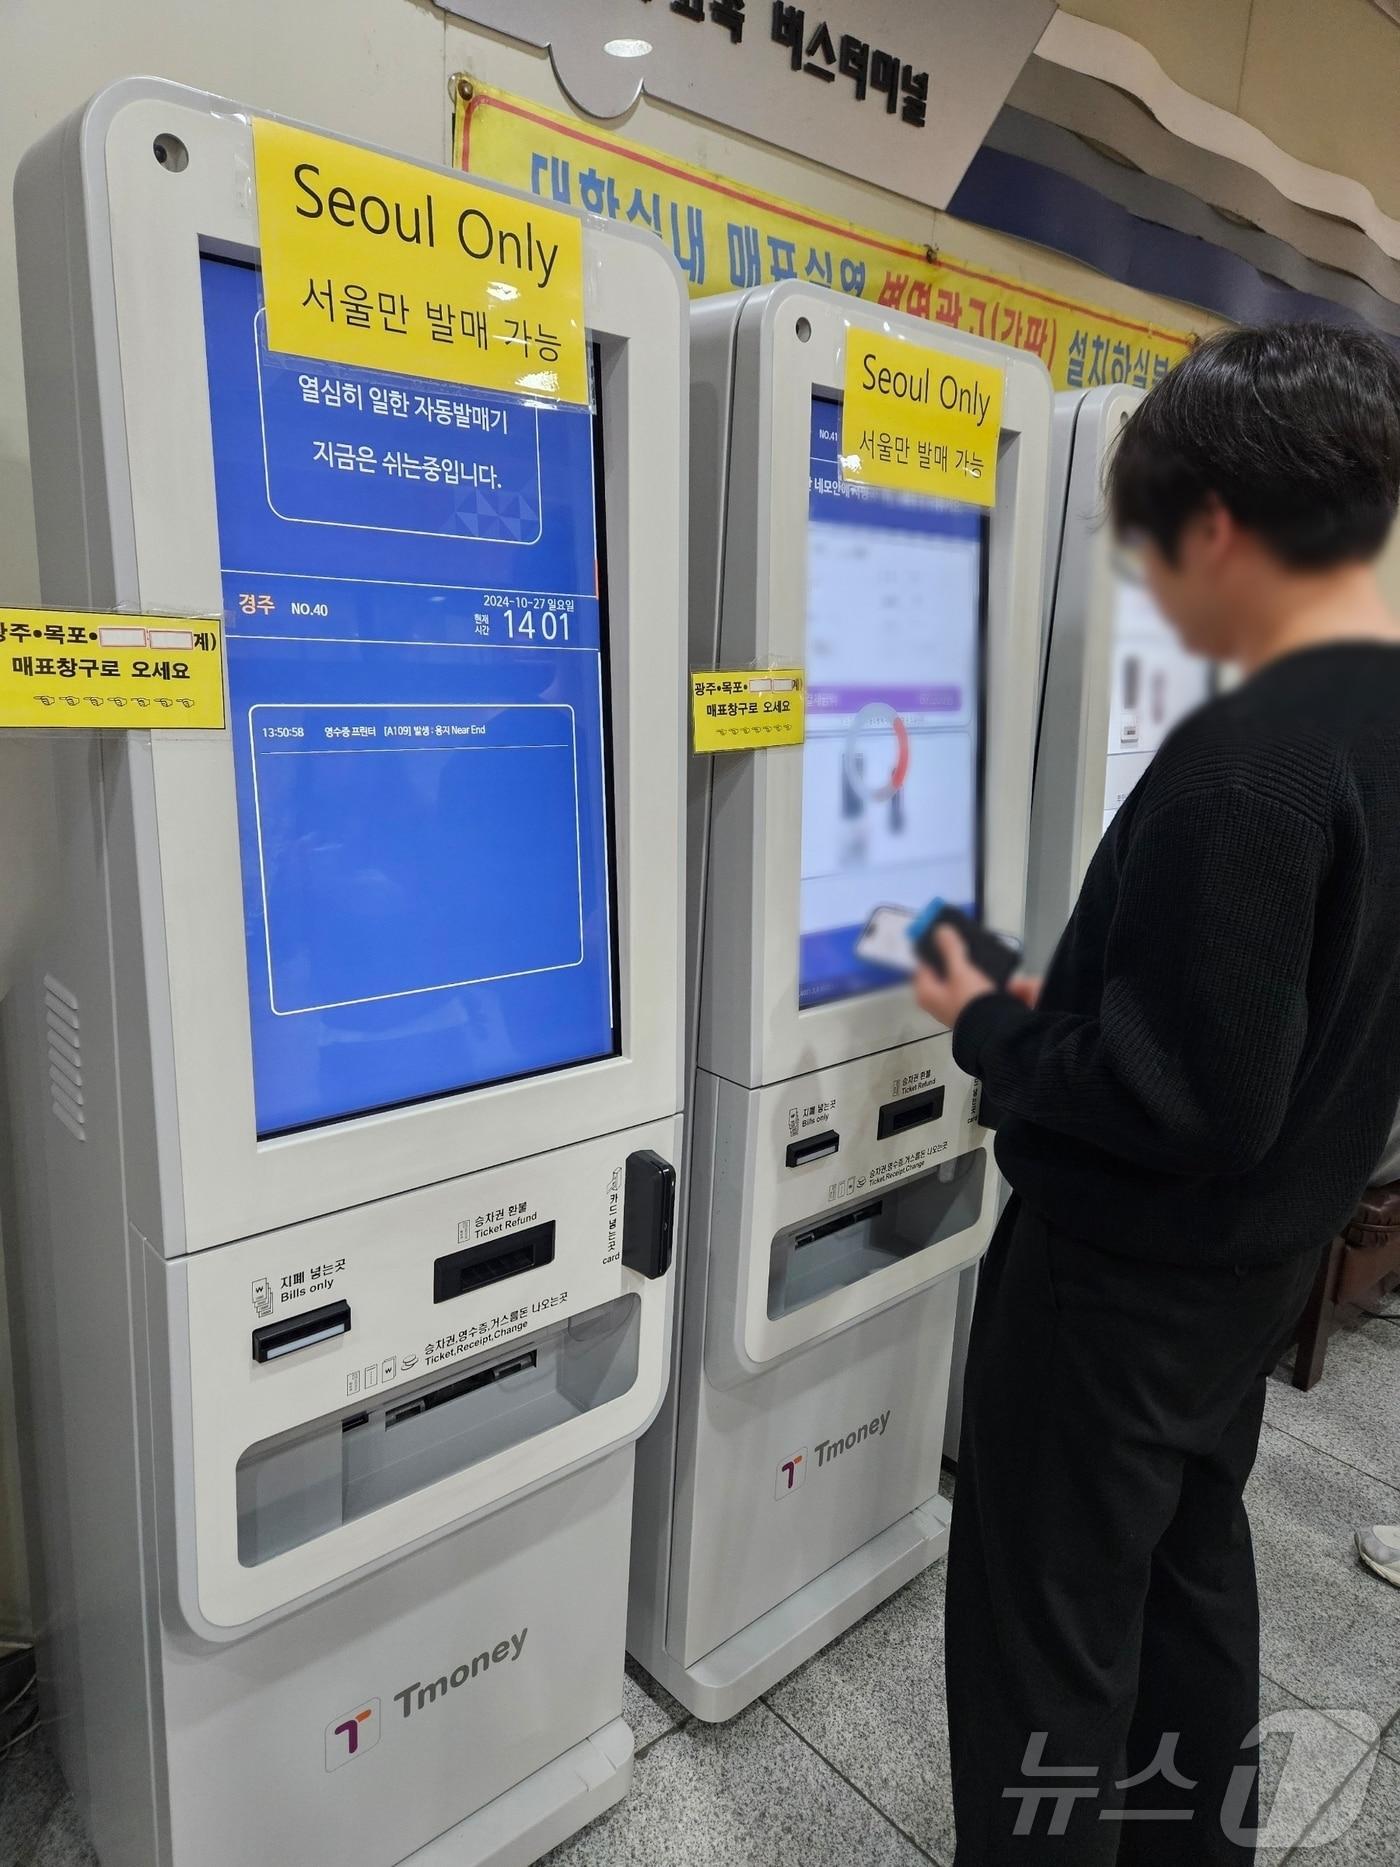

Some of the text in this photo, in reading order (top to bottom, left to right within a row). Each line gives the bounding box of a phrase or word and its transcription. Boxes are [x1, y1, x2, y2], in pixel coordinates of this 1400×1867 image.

[771, 0, 929, 127] 버스터미널
[294, 164, 558, 288] Seoul Only
[302, 278, 562, 362] 서울만 발매 가능
[862, 353, 991, 426] Seoul Only
[298, 374, 508, 434] 열심히 일한 자동발매기
[819, 429, 838, 442] NO.41
[313, 440, 502, 489] 지금은 쉬는중입니다.
[859, 430, 985, 479] 서울만 발매 가능
[238, 594, 328, 617] 경주 NO.40
[483, 595, 574, 612] 2024-10-27 일요일
[12, 656, 191, 680] 매표창구로 오세요
[706, 702, 758, 717] 매표창구로
[763, 700, 791, 713] 오세요
[262, 727, 304, 738] 13:50:58
[351, 725, 376, 737] 프린터
[384, 725, 412, 737] [A109]
[451, 725, 471, 736] Near
[471, 724, 486, 735] End
[475, 1208, 504, 1228] 승차권
[475, 1224, 502, 1238] Ticket
[505, 1212, 537, 1229] Refund
[602, 1252, 620, 1265] card
[281, 1279, 334, 1303] Bills only
[531, 1291, 569, 1313] 나오는곳
[814, 1409, 892, 1467] Tmoney
[394, 1627, 529, 1719] Tmoney
